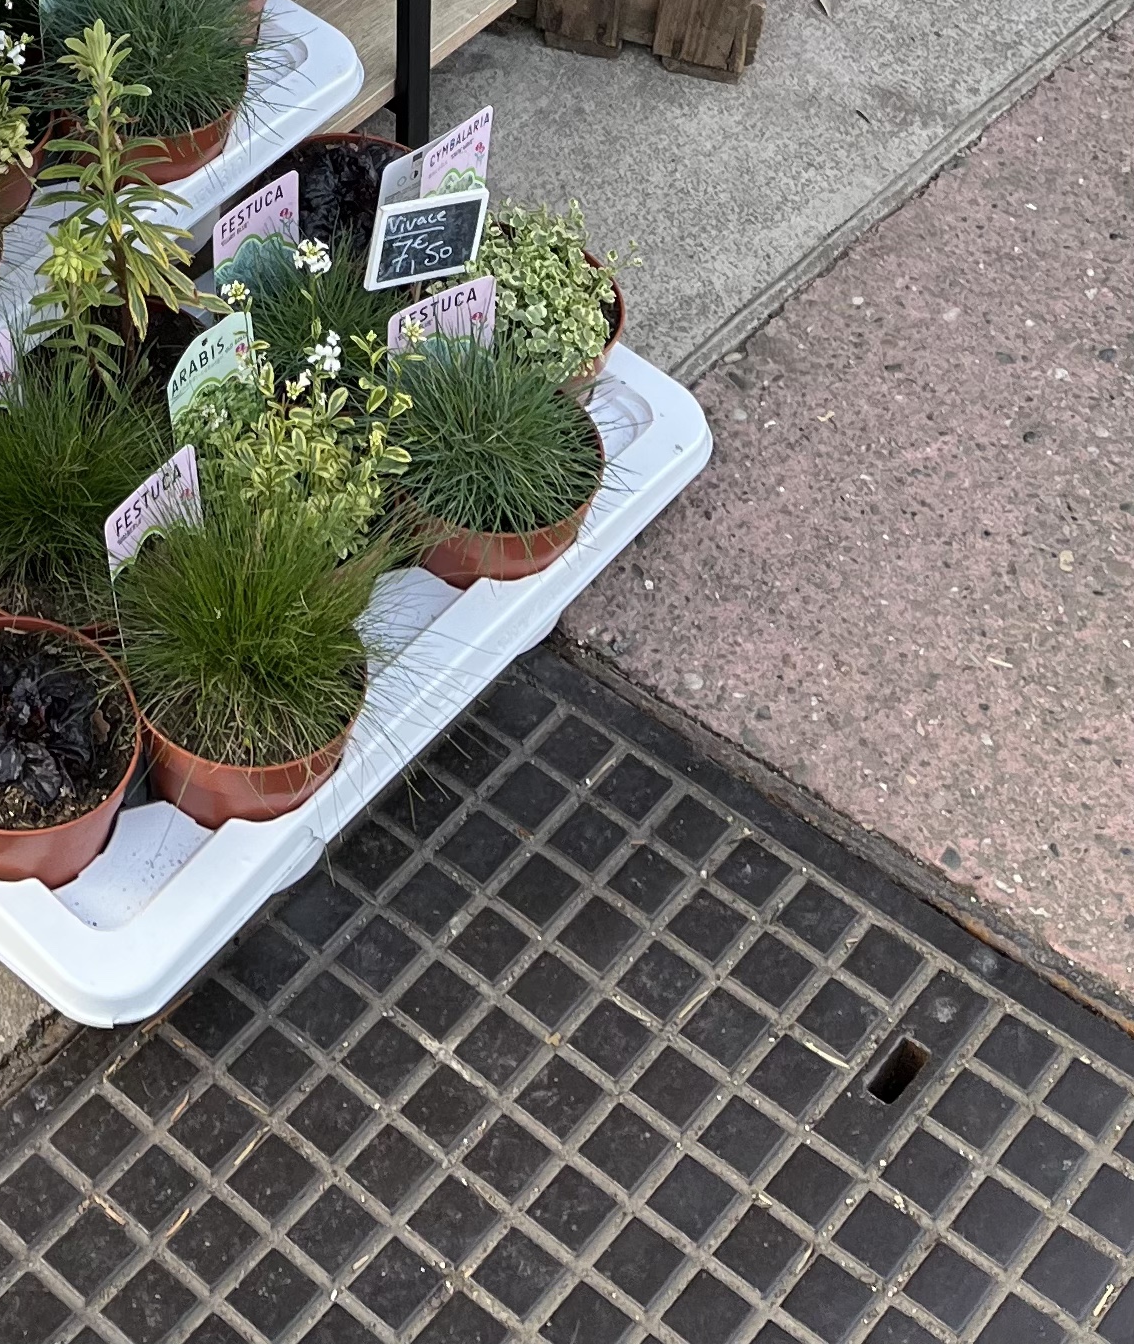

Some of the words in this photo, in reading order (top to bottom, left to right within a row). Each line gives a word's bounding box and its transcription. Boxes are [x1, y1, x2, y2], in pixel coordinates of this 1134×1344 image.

[429, 112, 490, 168] CYMBALARIA
[221, 184, 284, 240] FESTUCA
[387, 210, 447, 234] Vivace
[398, 287, 478, 334] FESTUCA
[172, 335, 224, 397] ARABIS
[115, 464, 181, 537] FESTUCA
